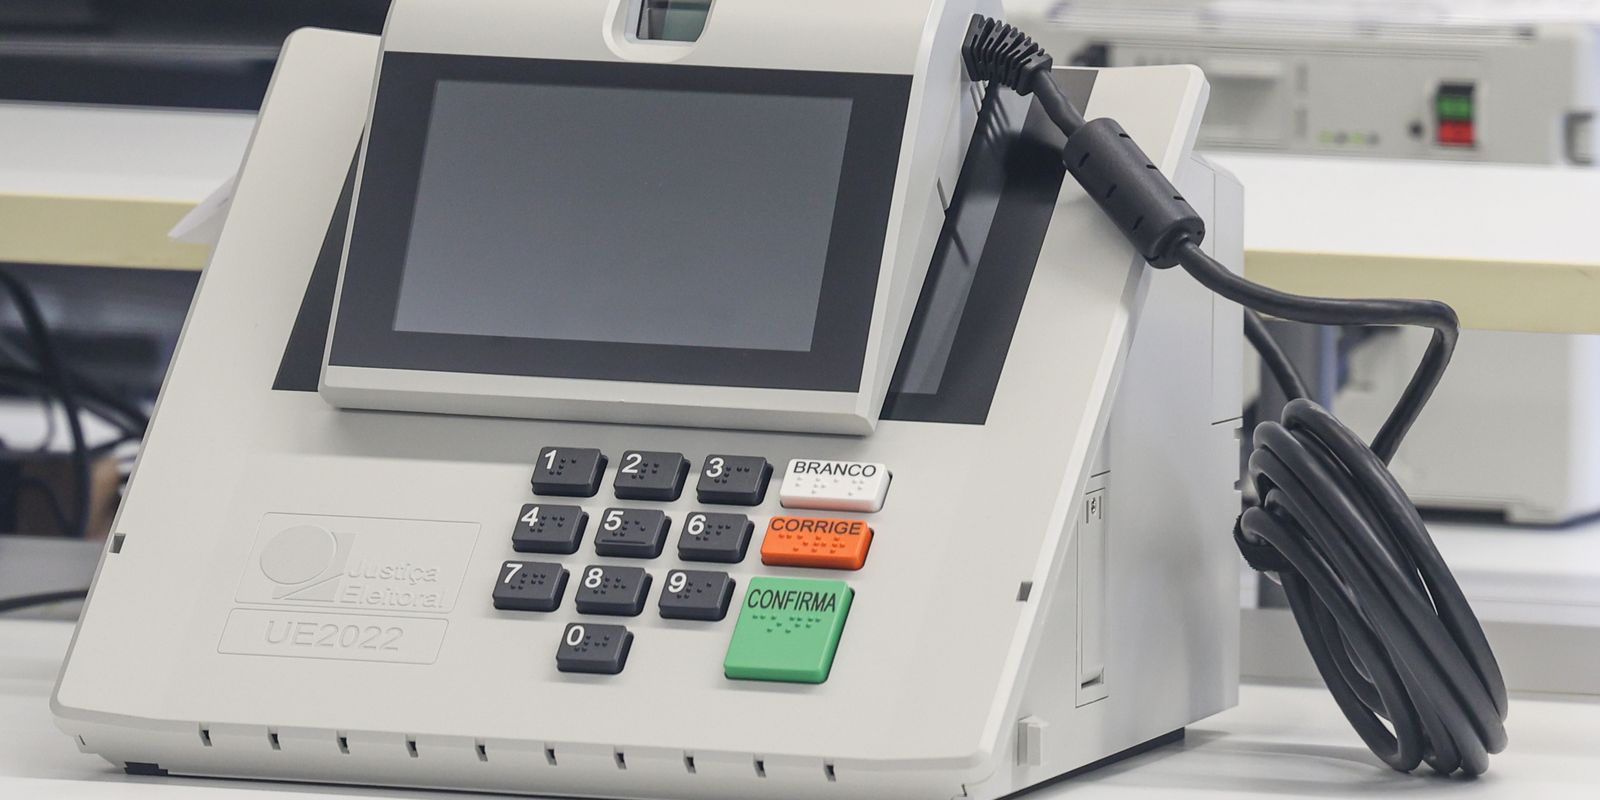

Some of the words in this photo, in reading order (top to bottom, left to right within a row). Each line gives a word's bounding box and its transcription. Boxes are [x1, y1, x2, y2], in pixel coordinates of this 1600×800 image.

[544, 449, 557, 470] 1
[621, 453, 643, 475] 2
[705, 457, 725, 478] 3
[793, 460, 877, 478] BRANCO
[520, 506, 540, 527] 4
[603, 510, 624, 531] 5
[687, 514, 707, 536] 6
[770, 517, 862, 536] CORRIGE
[347, 561, 438, 585] Justiça
[503, 563, 523, 584] 7
[584, 567, 603, 589] 8
[667, 571, 687, 594] 9
[340, 584, 445, 608] Eleitoral
[746, 588, 836, 613] CONFIRMA
[264, 619, 404, 652] UE2022
[566, 624, 585, 646] 0
